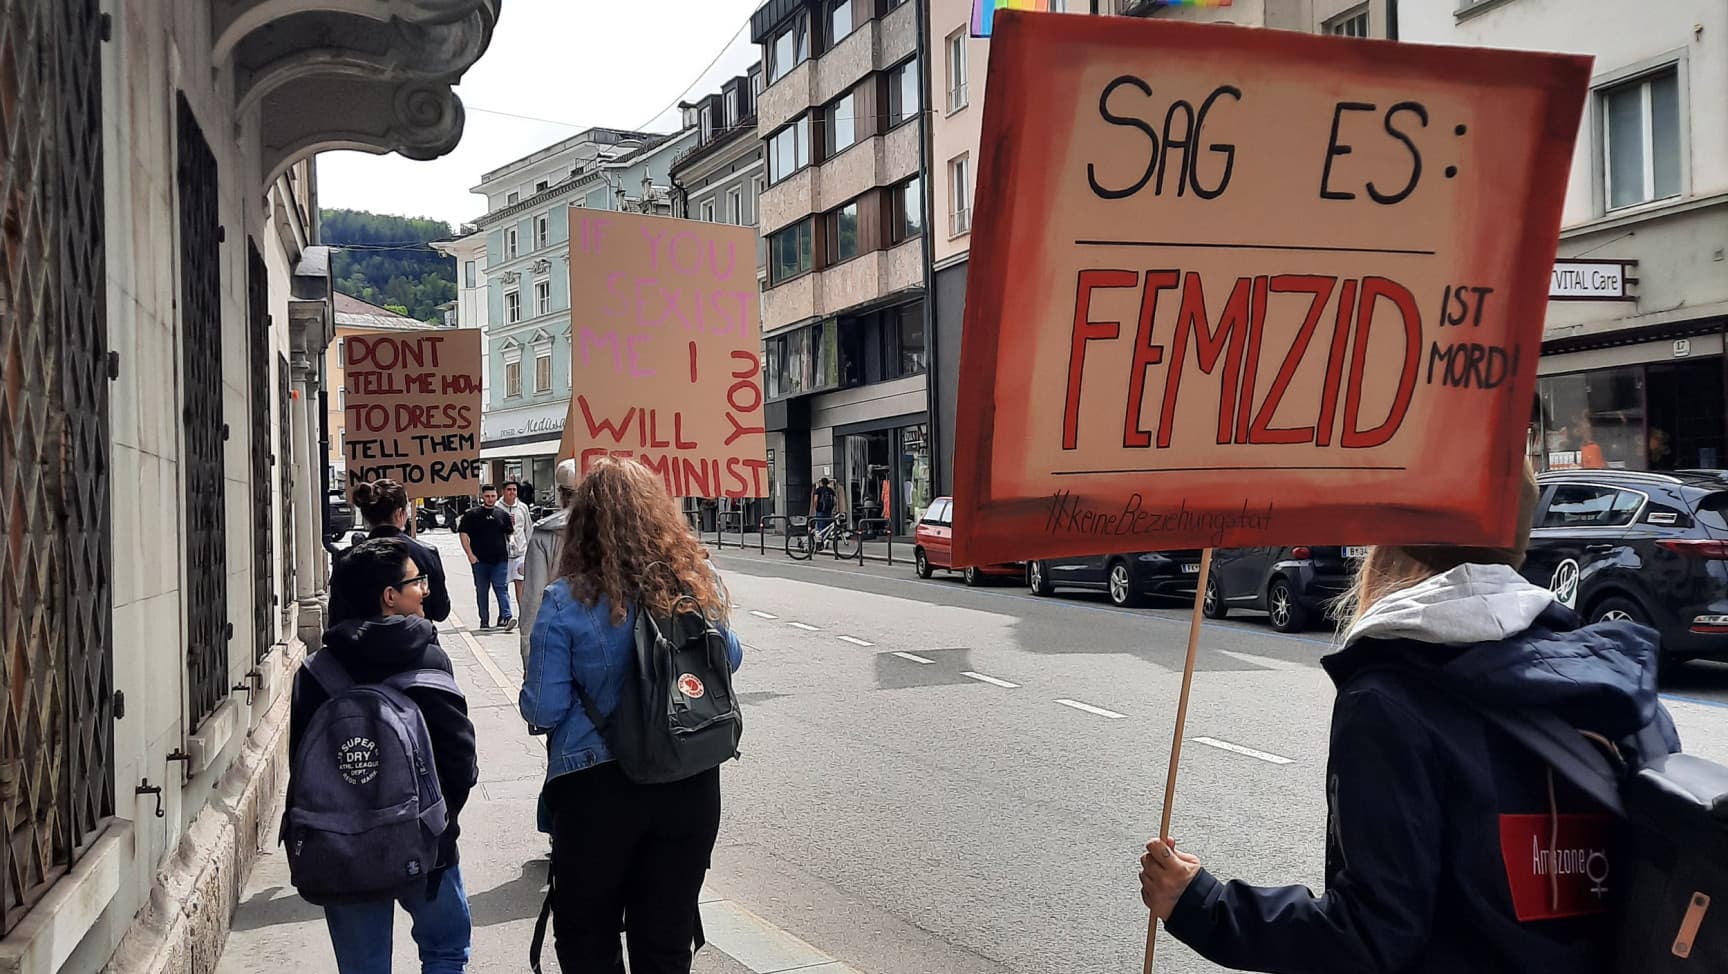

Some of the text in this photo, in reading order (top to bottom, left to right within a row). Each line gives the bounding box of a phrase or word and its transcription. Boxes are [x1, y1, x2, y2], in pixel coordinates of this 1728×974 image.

[1087, 75, 1467, 204] SAG ES:
[579, 217, 735, 281] IF YOU
[1592, 270, 1618, 290] Care
[602, 271, 755, 340] SEXIST
[1440, 285, 1493, 327] IST
[580, 325, 698, 384] ME I
[1062, 268, 1423, 450] FEMIZID
[1428, 341, 1520, 391] MORD!
[347, 371, 482, 395] TELL ME HOW
[724, 350, 765, 446] YOU
[346, 403, 472, 432] TO DRESS
[577, 394, 698, 450] WILL
[346, 439, 409, 460] TELL
[411, 432, 474, 456] THEM
[350, 458, 481, 487] NOT TO RAPE
[341, 737, 375, 752] SUPER
[346, 751, 371, 763] DRY
